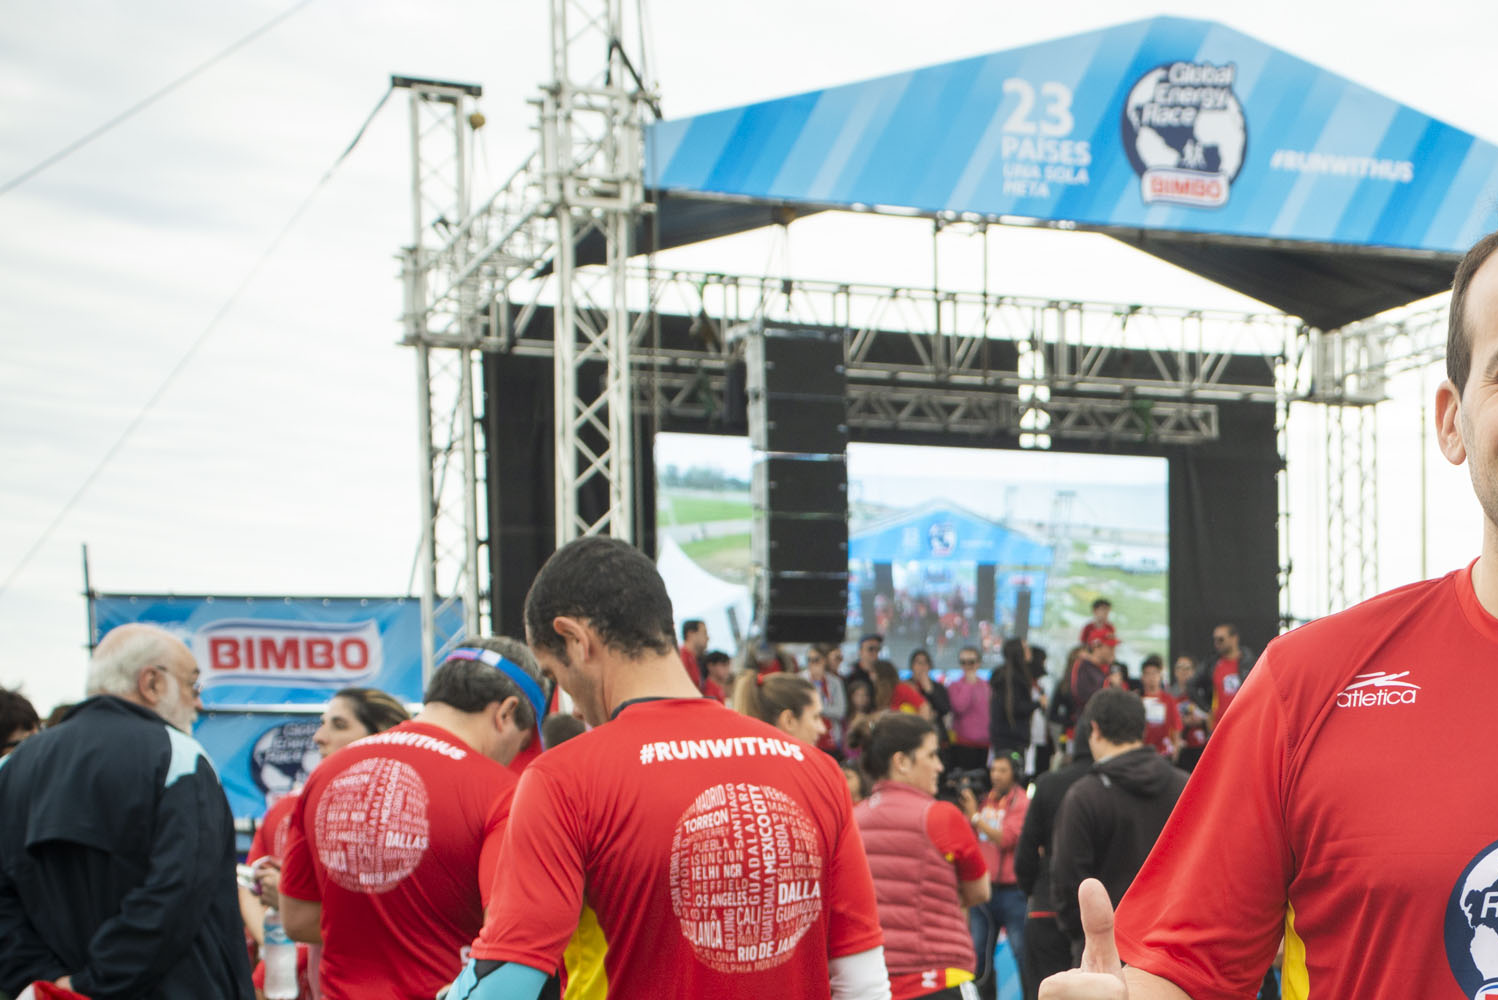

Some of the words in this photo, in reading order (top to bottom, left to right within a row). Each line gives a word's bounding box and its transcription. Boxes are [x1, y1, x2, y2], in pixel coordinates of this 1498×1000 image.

[1168, 61, 1235, 86] Global
[1002, 78, 1074, 137] 23
[1154, 84, 1229, 110] Energy
[1141, 102, 1197, 126] Race
[1045, 166, 1089, 185] SOLA
[1269, 149, 1415, 184] #RUNWITHUS
[1149, 176, 1223, 199] BIMBO
[208, 635, 370, 671] BIMBO
[1336, 688, 1417, 708] atletica
[639, 736, 805, 765] #RUNWITHUS
[746, 783, 768, 815] CITY
[683, 807, 730, 835] TORREON
[725, 782, 745, 849] SANTIAGO
[385, 830, 429, 850] DALLAS
[735, 782, 761, 906] GUADALAJARA
[757, 814, 778, 875] MEXICO
[773, 823, 792, 868] LISBOA
[690, 878, 749, 894] HEFFIELD
[710, 890, 748, 907] ANGELES
[777, 880, 821, 905] DALLA
[736, 906, 761, 926] CALI
[761, 876, 777, 941] GUATEMALA
[723, 907, 736, 951] BEIJING
[737, 944, 758, 962] RIO
[758, 940, 775, 960] DE
